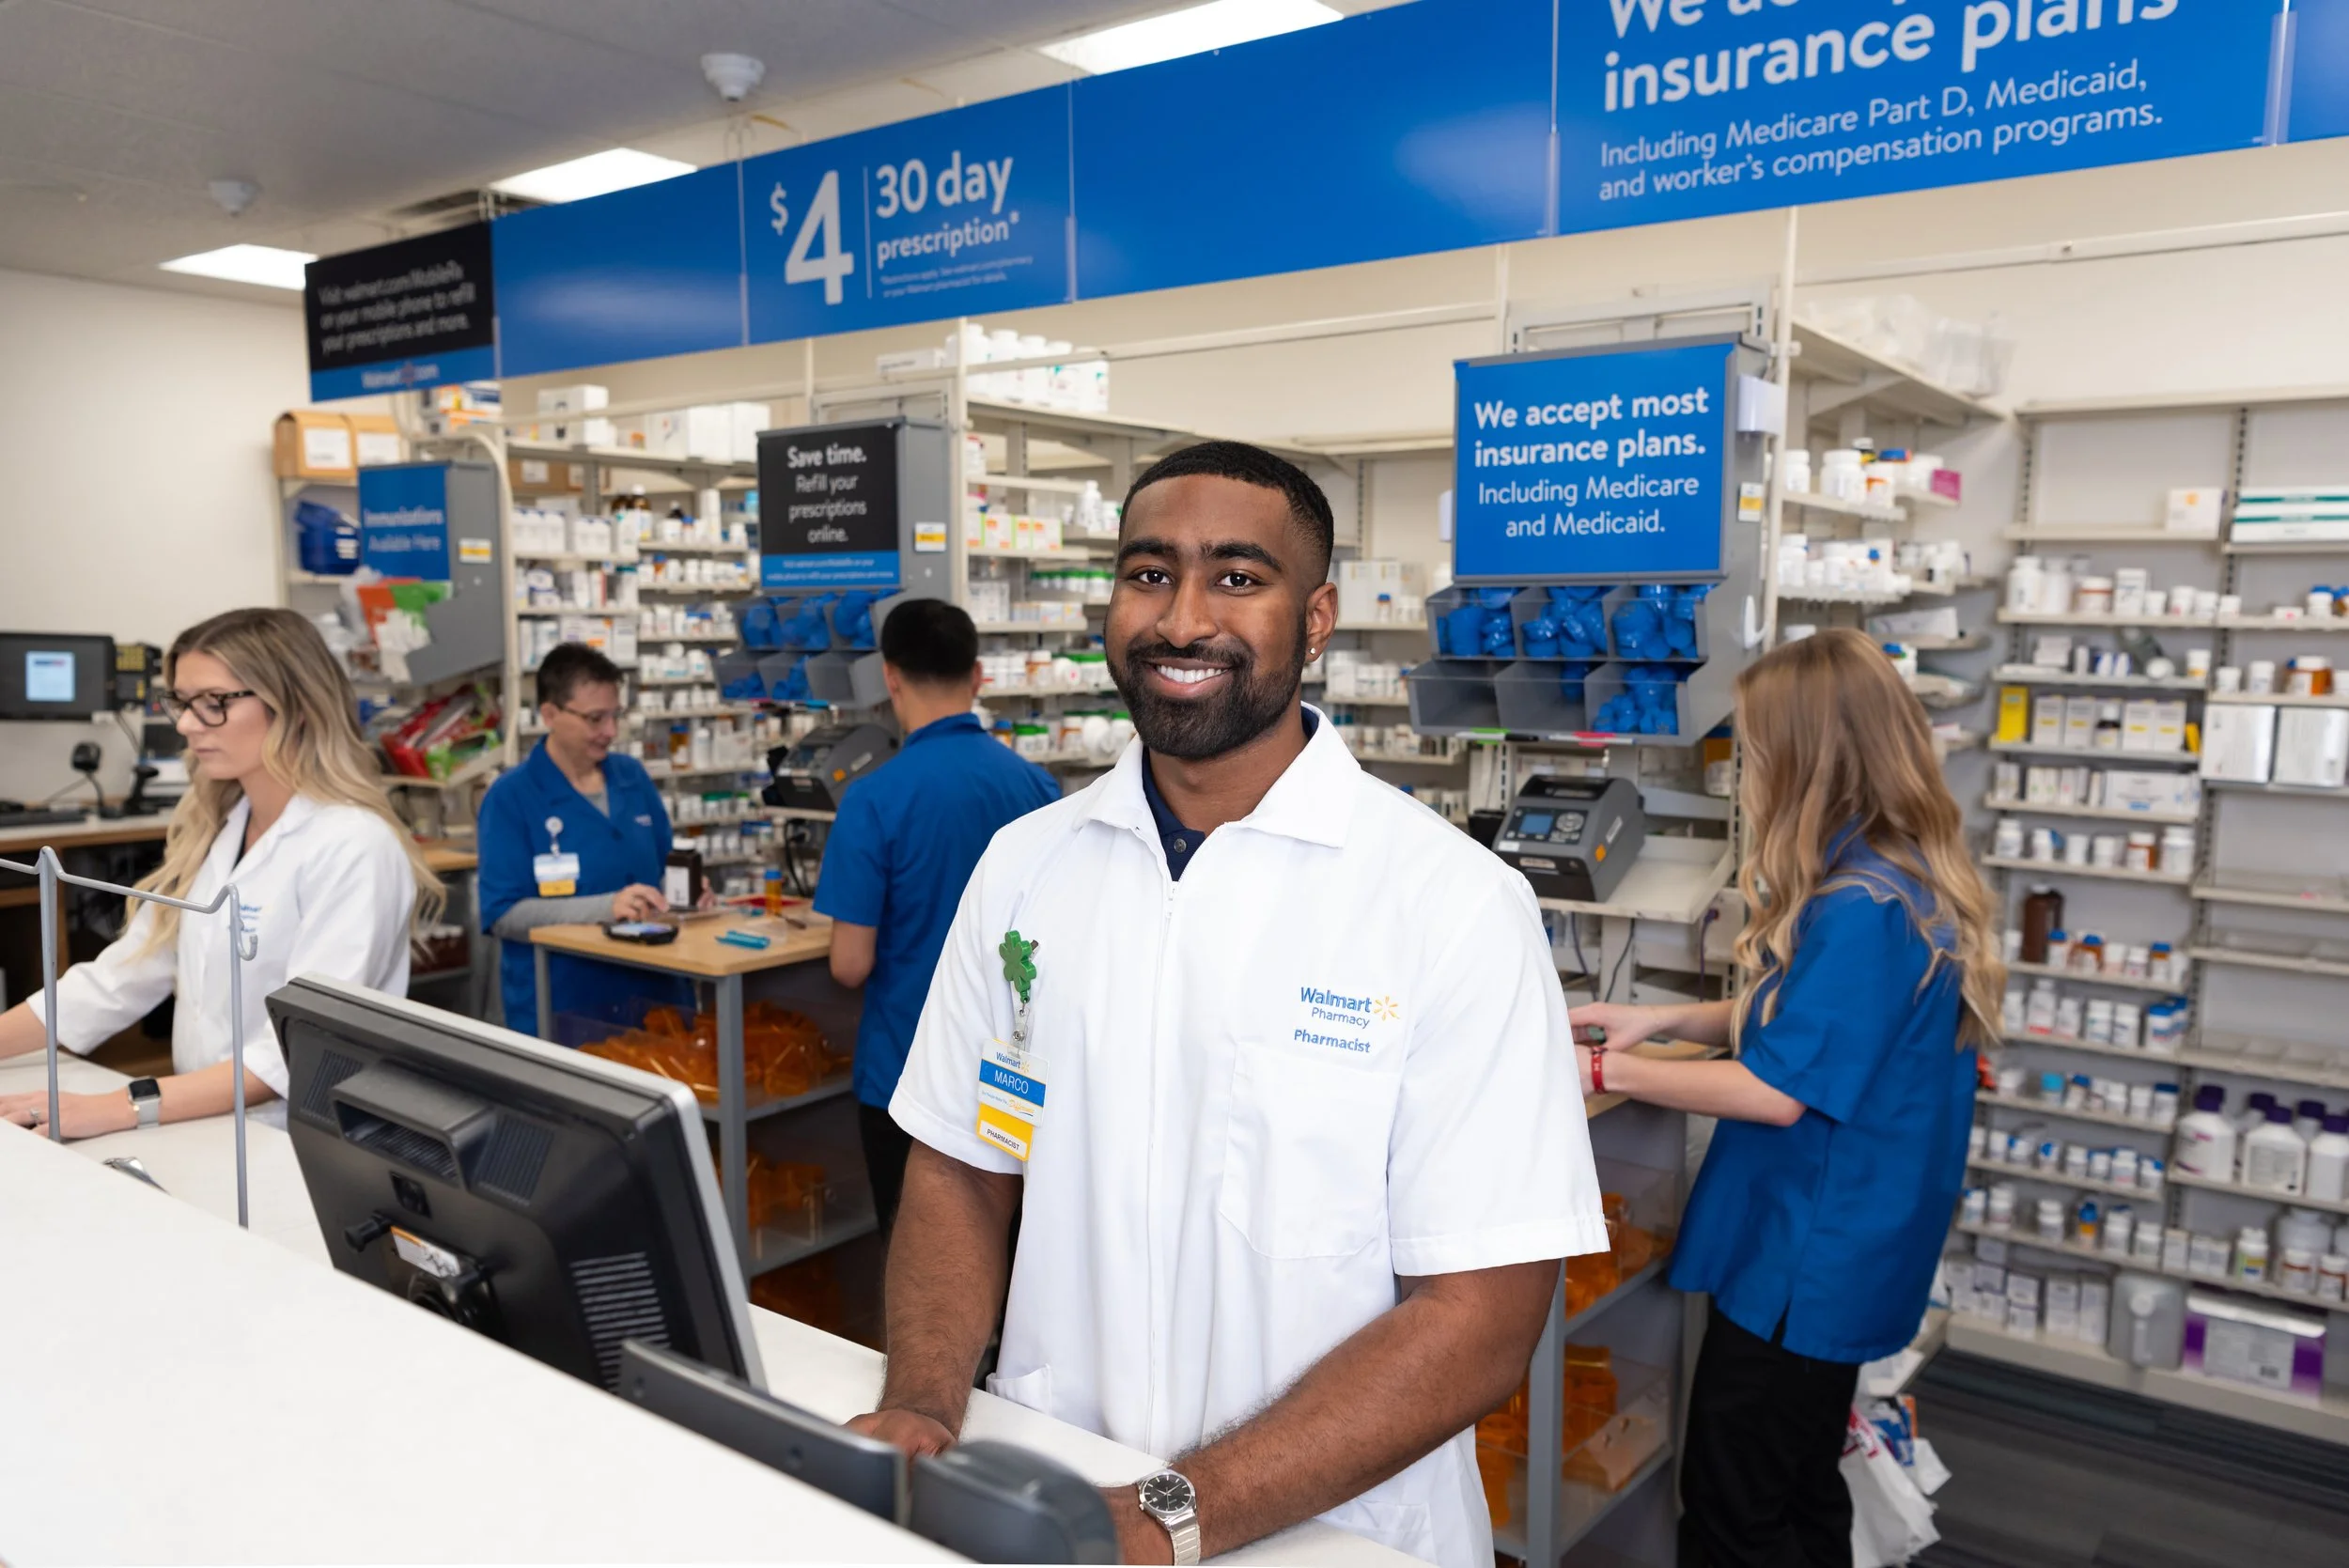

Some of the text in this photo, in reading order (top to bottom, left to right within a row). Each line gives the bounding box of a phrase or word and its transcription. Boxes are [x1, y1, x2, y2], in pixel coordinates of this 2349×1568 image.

[1604, 13, 1936, 113] insurance
[1600, 57, 2147, 167] Including Medicare Part D, Medicaid,
[1598, 169, 1645, 201] and
[1772, 126, 1983, 176] compensation
[1993, 103, 2163, 155] programs.
[876, 149, 1014, 219] 30 day
[1474, 386, 1709, 430] We accept most
[787, 442, 867, 469] Save time.
[1474, 428, 1706, 468] insurance plans.
[796, 473, 859, 496] Refill your
[1478, 474, 1700, 507] Including Medicare
[788, 498, 867, 524] prescriptions
[1505, 508, 1665, 537] and Medicaid.
[807, 524, 848, 543] online.
[1300, 986, 1372, 1013] Walmart
[1312, 1007, 1370, 1030] Pharmacy
[1294, 1029, 1371, 1053] Pharmacist
[996, 1051, 1020, 1069] Walmart
[994, 1069, 1029, 1094] MARCO
[987, 1128, 1020, 1151] PHARMACIST
